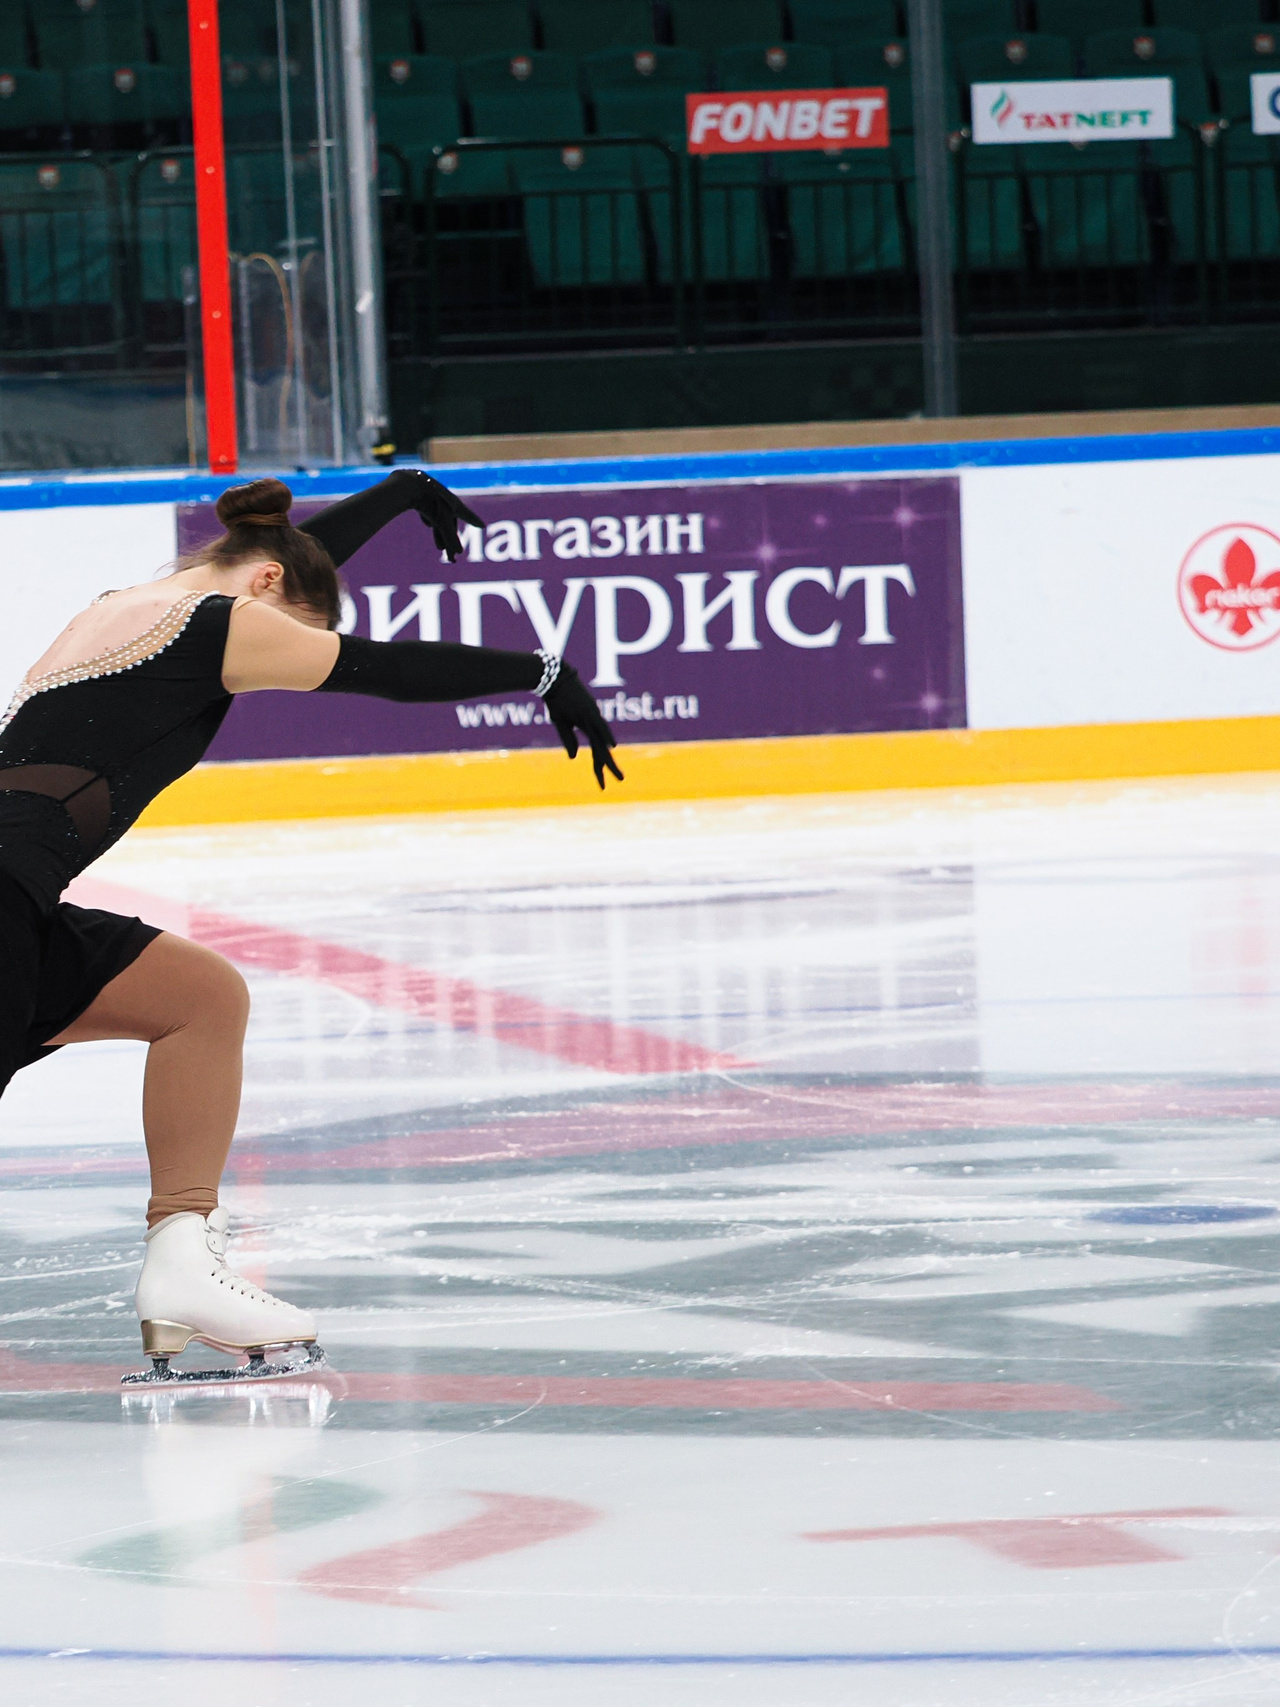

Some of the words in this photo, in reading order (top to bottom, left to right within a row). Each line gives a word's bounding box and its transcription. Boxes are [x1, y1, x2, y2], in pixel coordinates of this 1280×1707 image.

[689, 97, 884, 144] FONBET
[1019, 109, 1152, 131] TATNEFT
[335, 563, 917, 688] игурист
[456, 691, 700, 728] www.rist.ru
